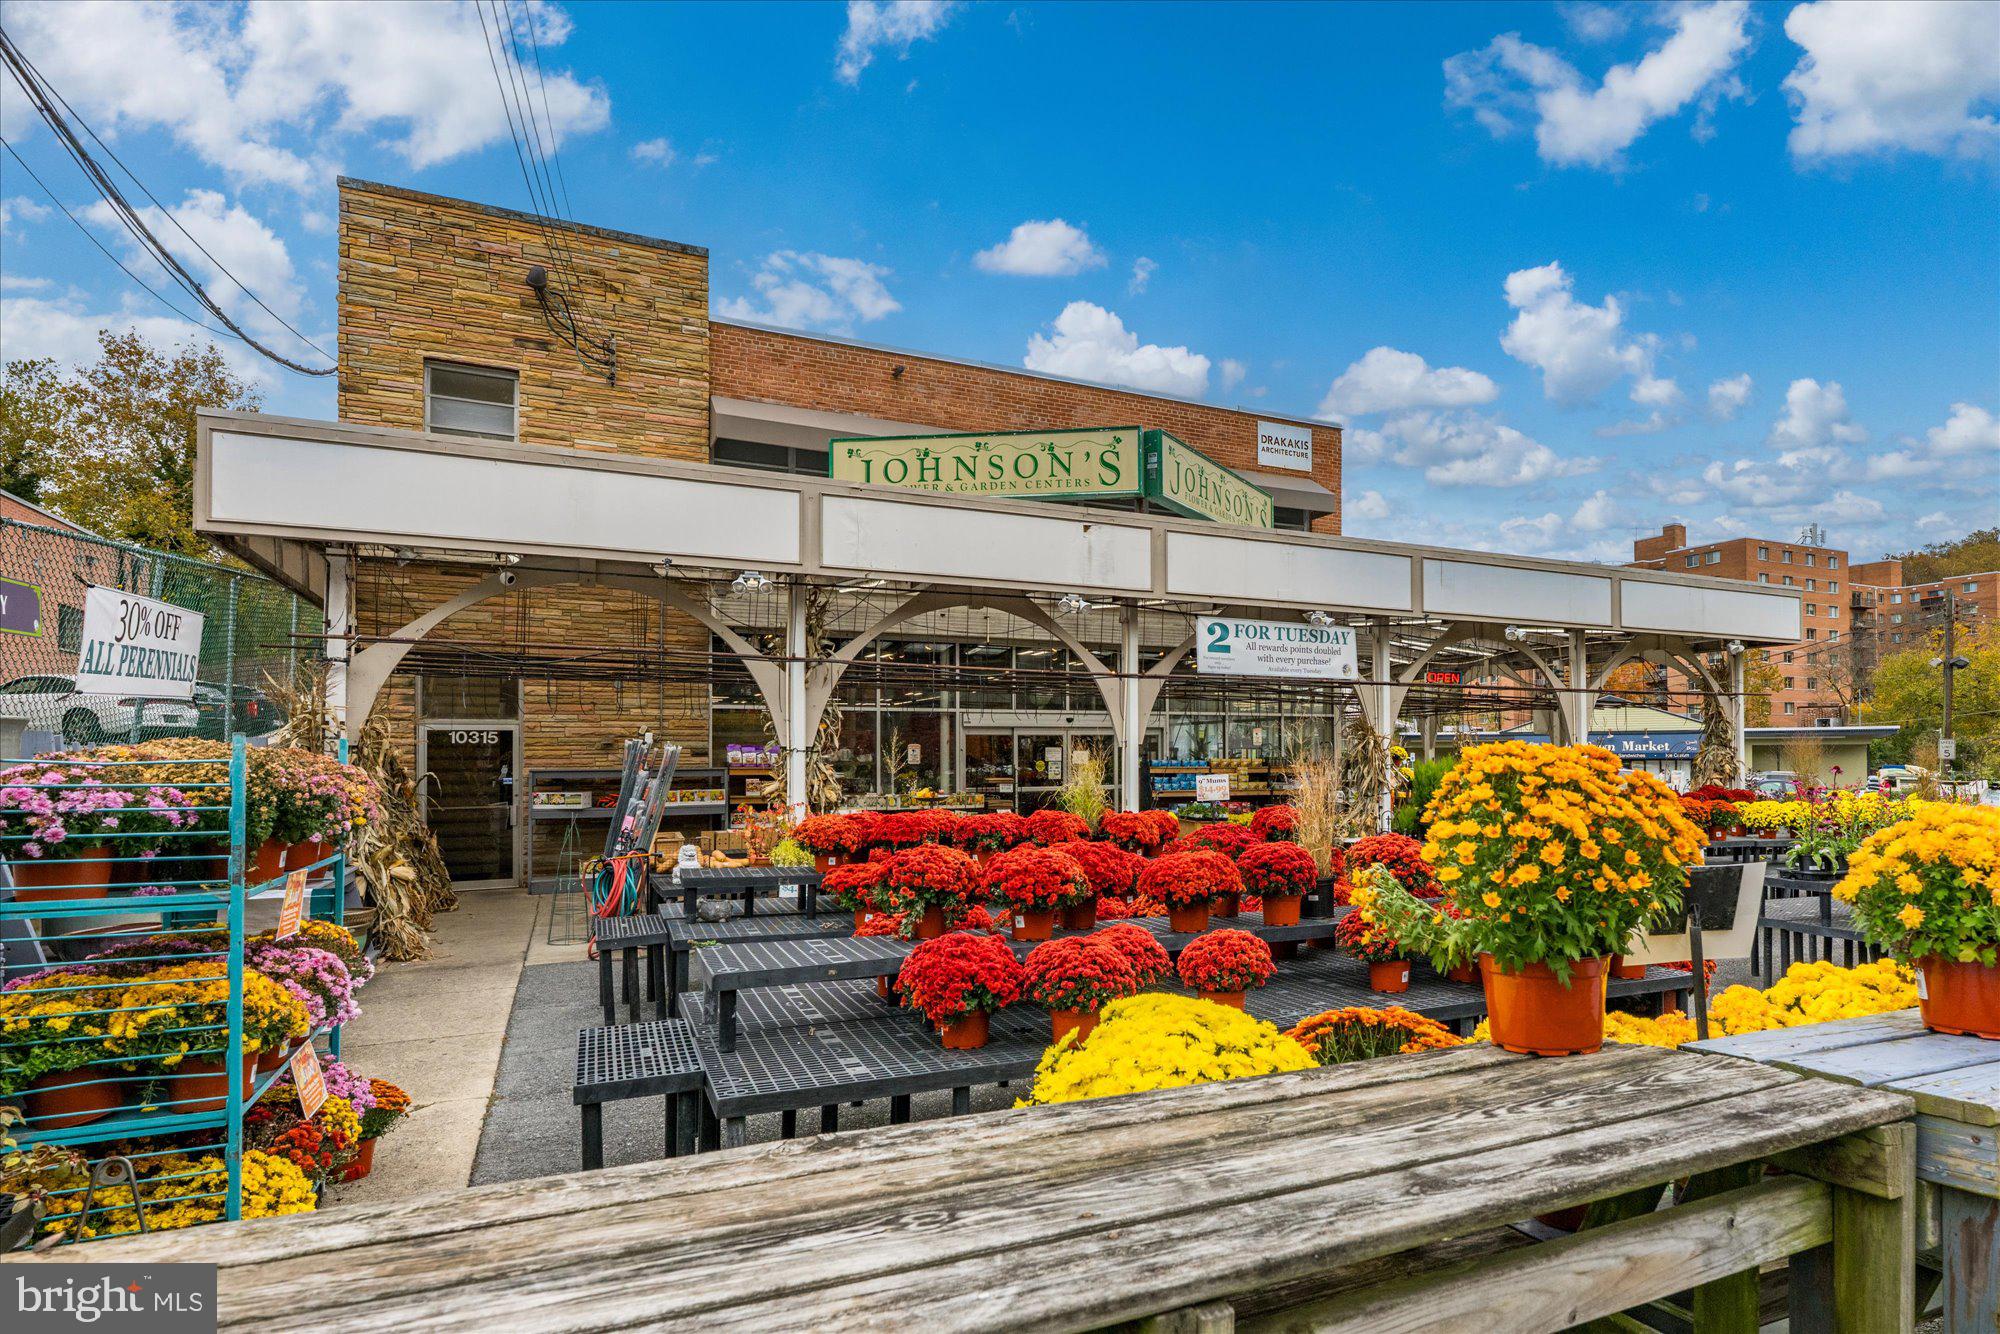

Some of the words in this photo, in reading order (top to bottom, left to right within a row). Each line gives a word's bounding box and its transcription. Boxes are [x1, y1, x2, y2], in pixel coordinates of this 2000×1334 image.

[1261, 434, 1309, 450] DRAKAKIS
[1261, 446, 1309, 459] ARCHITECTURE
[945, 483, 954, 492] &
[960, 480, 1017, 492] GARDEN
[1025, 478, 1091, 489] CENTERS
[1169, 460, 1267, 528] JOHNSON'S
[1184, 491, 1208, 510] FLOWER
[114, 600, 152, 643] 30%
[154, 610, 182, 641] OFF
[1207, 622, 1231, 654] 2
[1234, 623, 1271, 641] FOR
[1274, 626, 1351, 646] TUESDAY
[1246, 641, 1257, 651] All
[1258, 643, 1288, 653] rewards
[1289, 645, 1313, 655] points
[1314, 645, 1342, 656] doubled
[80, 639, 115, 676] ALL
[116, 644, 197, 683] PERENNIALS
[1257, 653, 1274, 663] with
[1275, 656, 1295, 666] every
[1296, 657, 1331, 667] purchase!
[1427, 671, 1460, 683] OPEN
[448, 730, 499, 744] 10315
[1622, 740, 1670, 751] Market
[1943, 749, 1951, 758] 5
